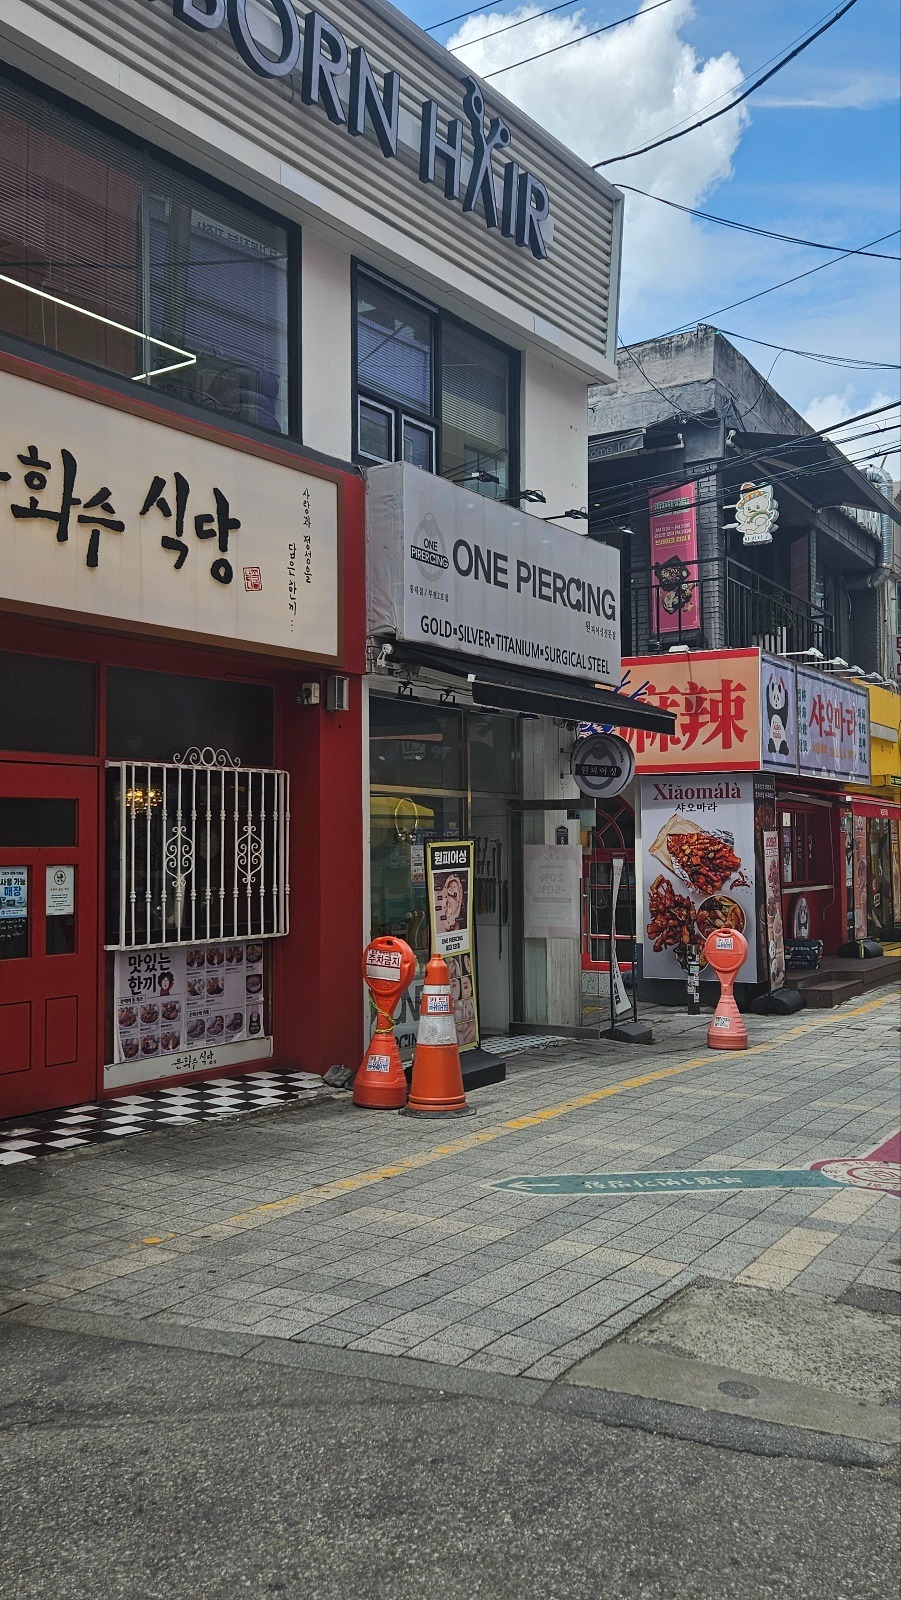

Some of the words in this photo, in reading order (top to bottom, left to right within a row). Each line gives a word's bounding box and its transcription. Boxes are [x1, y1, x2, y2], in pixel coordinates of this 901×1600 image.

[173, 0, 400, 158] ORN
[419, 75, 550, 260] HAIR
[0, 445, 126, 568] 화수
[139, 472, 242, 585] 식당
[423, 538, 438, 552] ONE
[453, 538, 509, 590] ONE
[516, 559, 616, 622] PIERCING
[421, 615, 452, 639] GOLD
[457, 625, 491, 648] SILVER
[496, 633, 541, 659] TITANIUM
[544, 645, 587, 670] SURGICAL
[587, 656, 611, 675] STEEL
[808, 694, 858, 745] 샤오마라
[674, 802, 718, 813] 샤오마라
[434, 849, 467, 866] 원피어싱
[4, 886, 21, 897] 매장
[128, 952, 172, 975] 맛있는
[368, 953, 400, 967] 주차금지
[128, 974, 157, 996] 한끼
